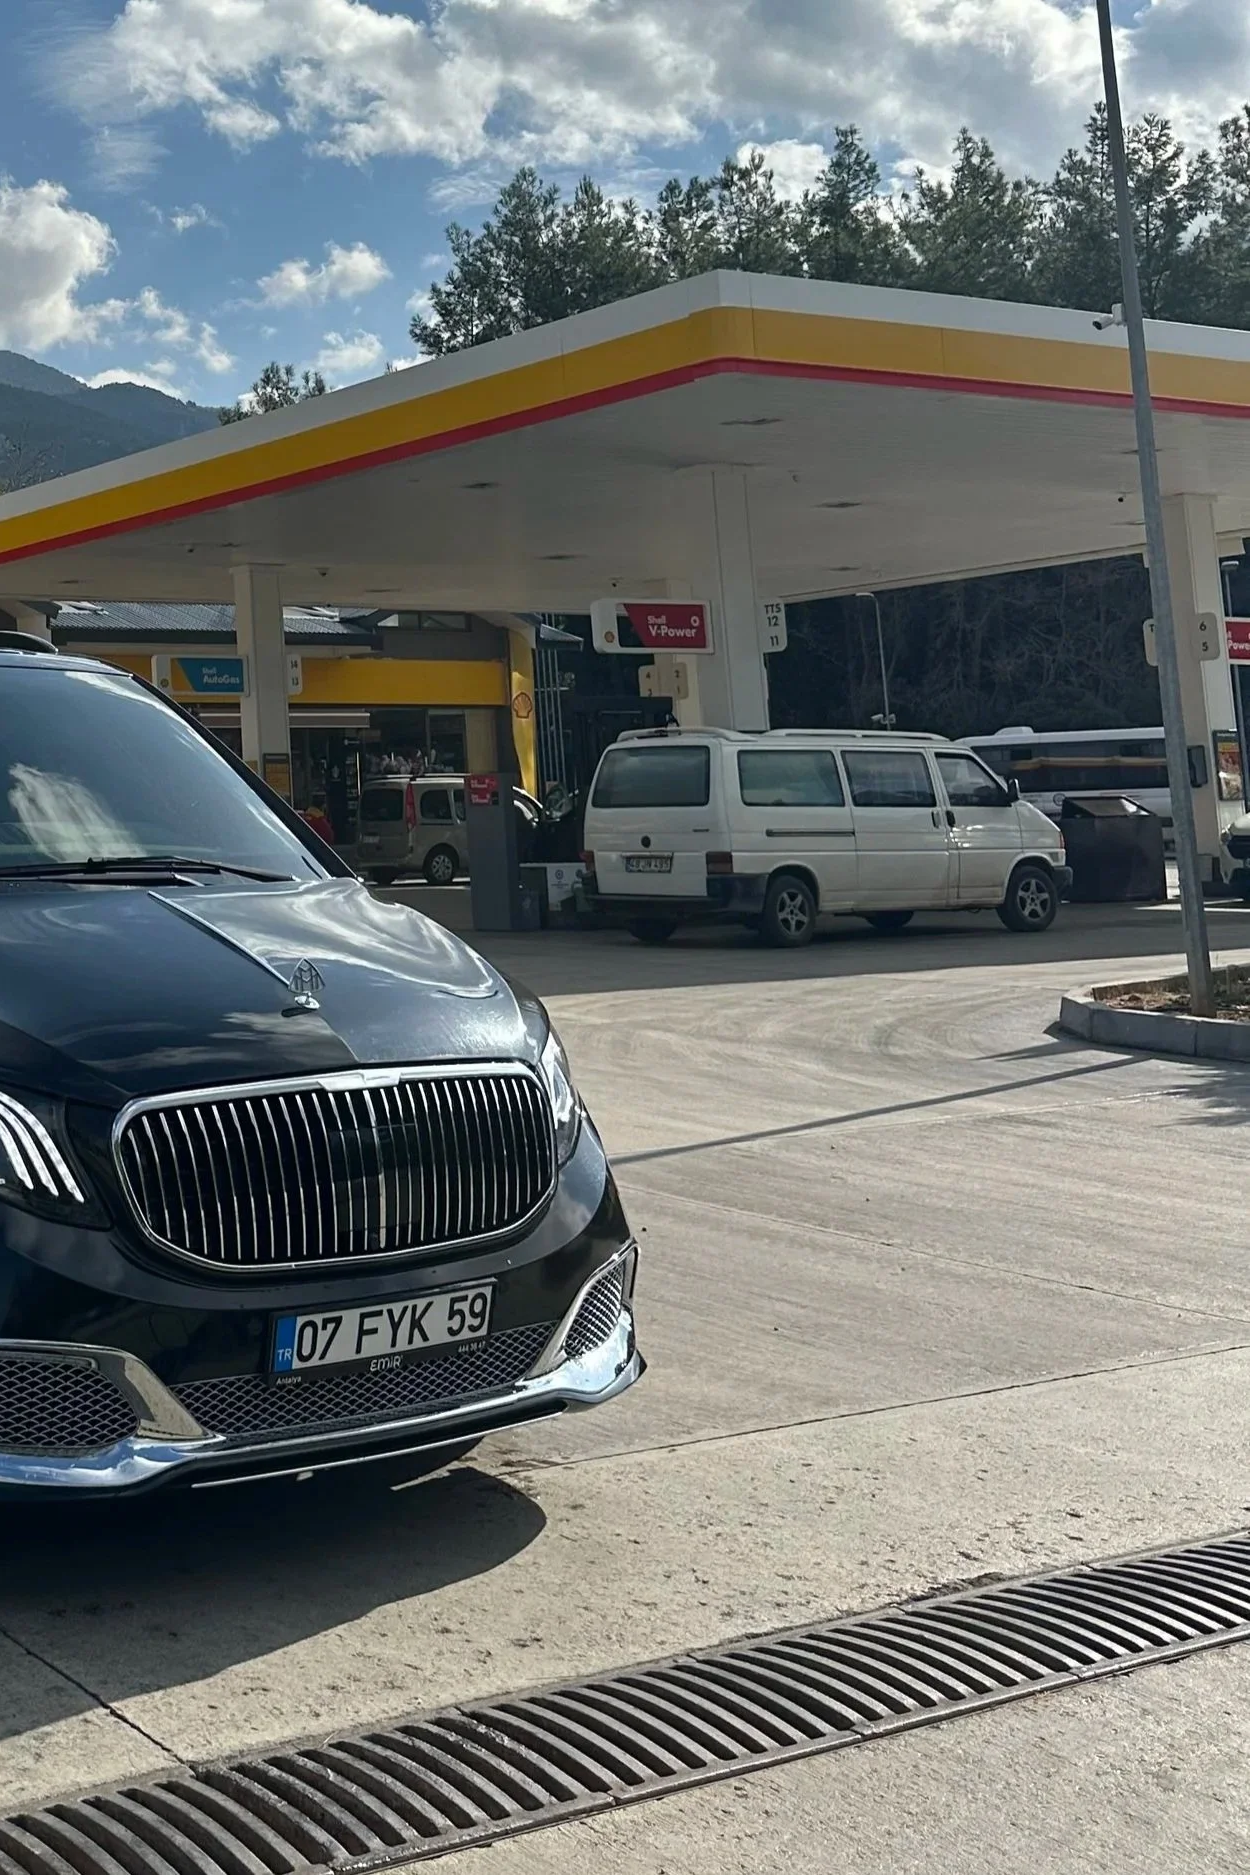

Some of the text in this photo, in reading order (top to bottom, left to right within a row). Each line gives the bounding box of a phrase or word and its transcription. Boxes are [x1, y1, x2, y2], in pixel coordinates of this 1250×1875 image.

[647, 615, 666, 624] Shell
[767, 616, 780, 627] 12
[1199, 620, 1207, 631] 6
[649, 625, 697, 638] V-Power
[1202, 641, 1209, 652] 5
[203, 675, 240, 684] AutoGas
[277, 1291, 488, 1363] TR 07 FYK 59
